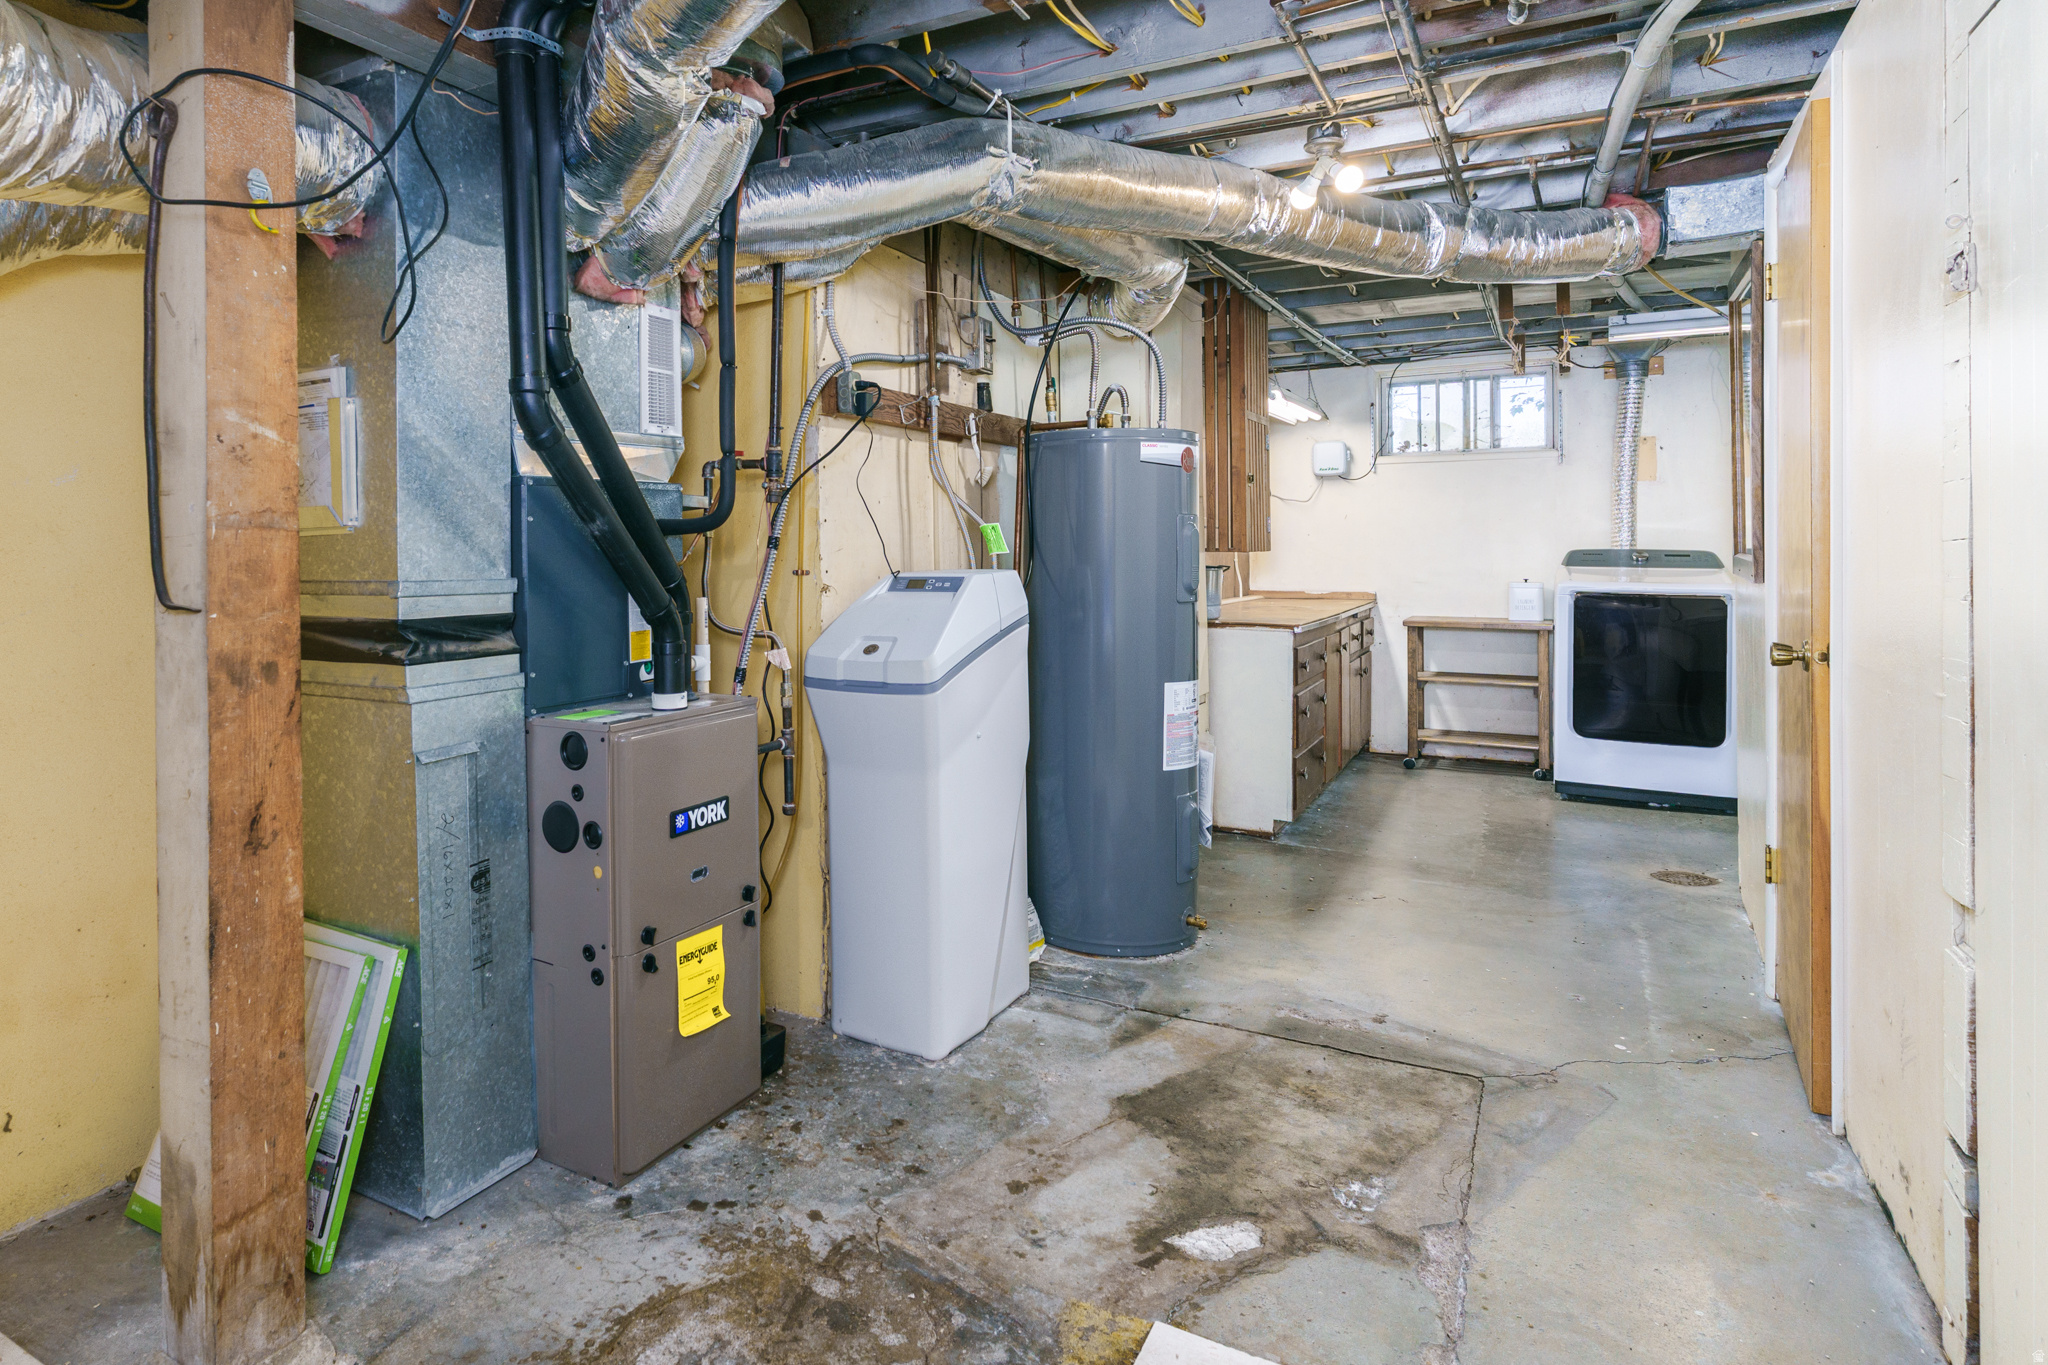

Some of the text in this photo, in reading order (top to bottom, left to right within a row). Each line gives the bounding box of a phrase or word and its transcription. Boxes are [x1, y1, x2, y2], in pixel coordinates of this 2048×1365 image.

[688, 799, 727, 830] YORK
[360, 965, 371, 984] ACE
[394, 958, 405, 978] ACE
